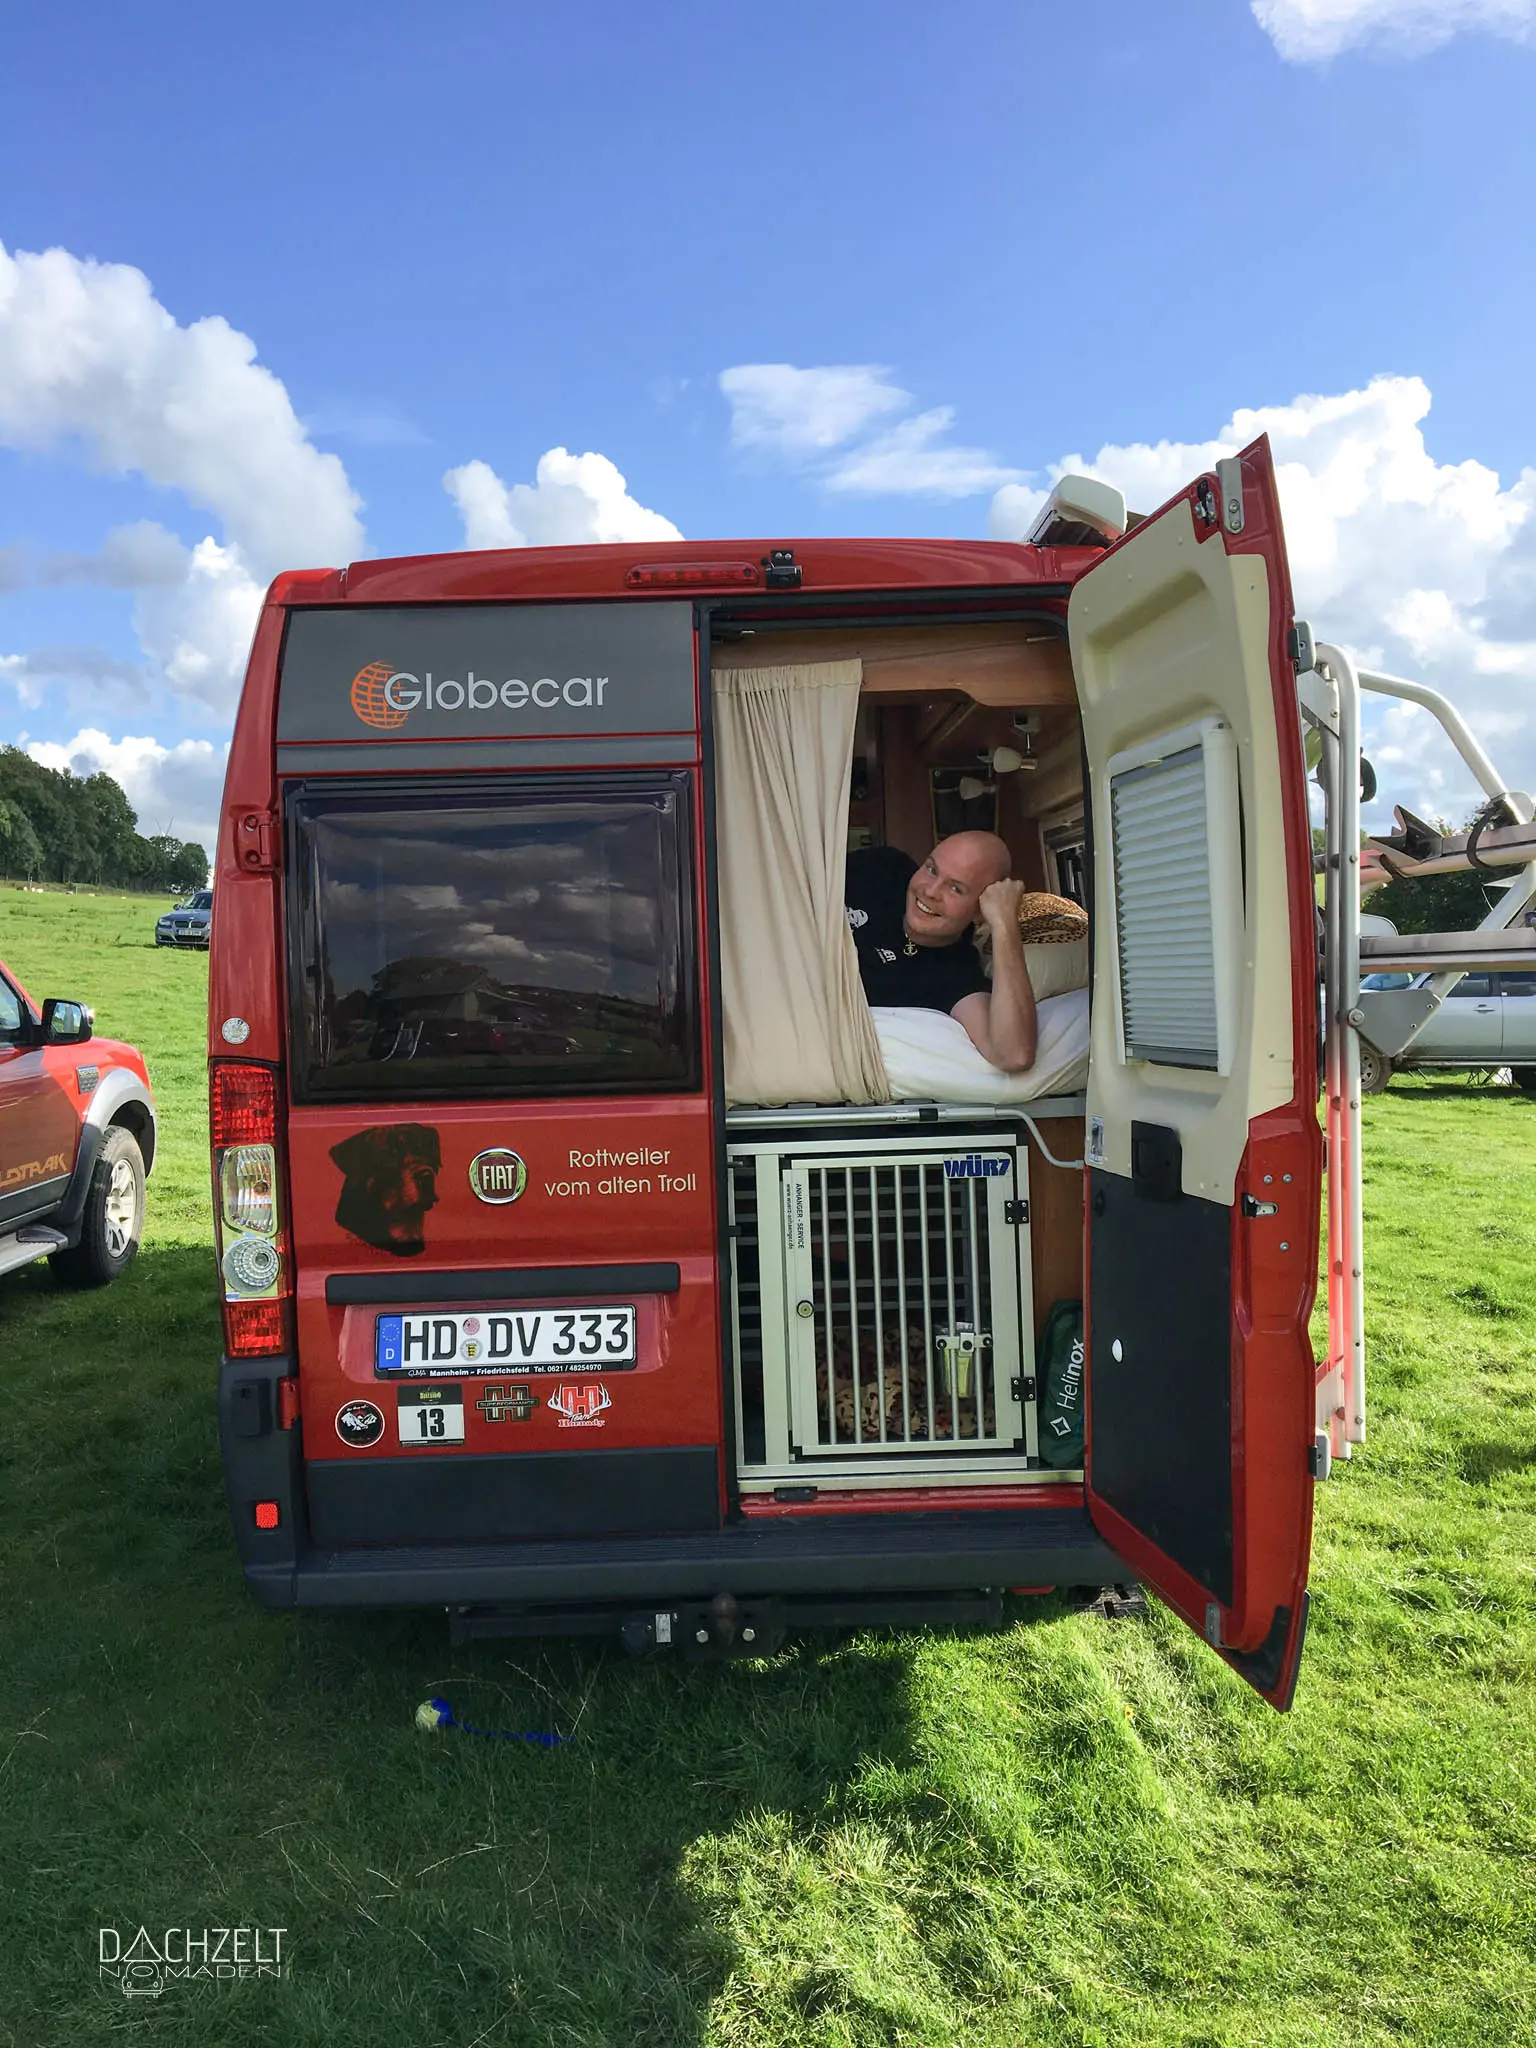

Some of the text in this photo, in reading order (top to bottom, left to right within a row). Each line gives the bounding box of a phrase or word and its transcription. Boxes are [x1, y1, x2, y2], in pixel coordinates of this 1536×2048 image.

[383, 672, 609, 710] Globecar
[568, 1147, 671, 1169] Rottweiler
[481, 1164, 516, 1191] FIAT
[544, 1173, 697, 1197] vom alten Troll
[797, 1222, 805, 1249] SERVICE
[404, 1313, 629, 1361] HD DV 333
[385, 1348, 395, 1360] D
[429, 1369, 469, 1377] Mannheim
[476, 1366, 530, 1375] Friedrichsfeld
[1056, 1337, 1085, 1410] Helinox
[416, 1408, 445, 1437] 13
